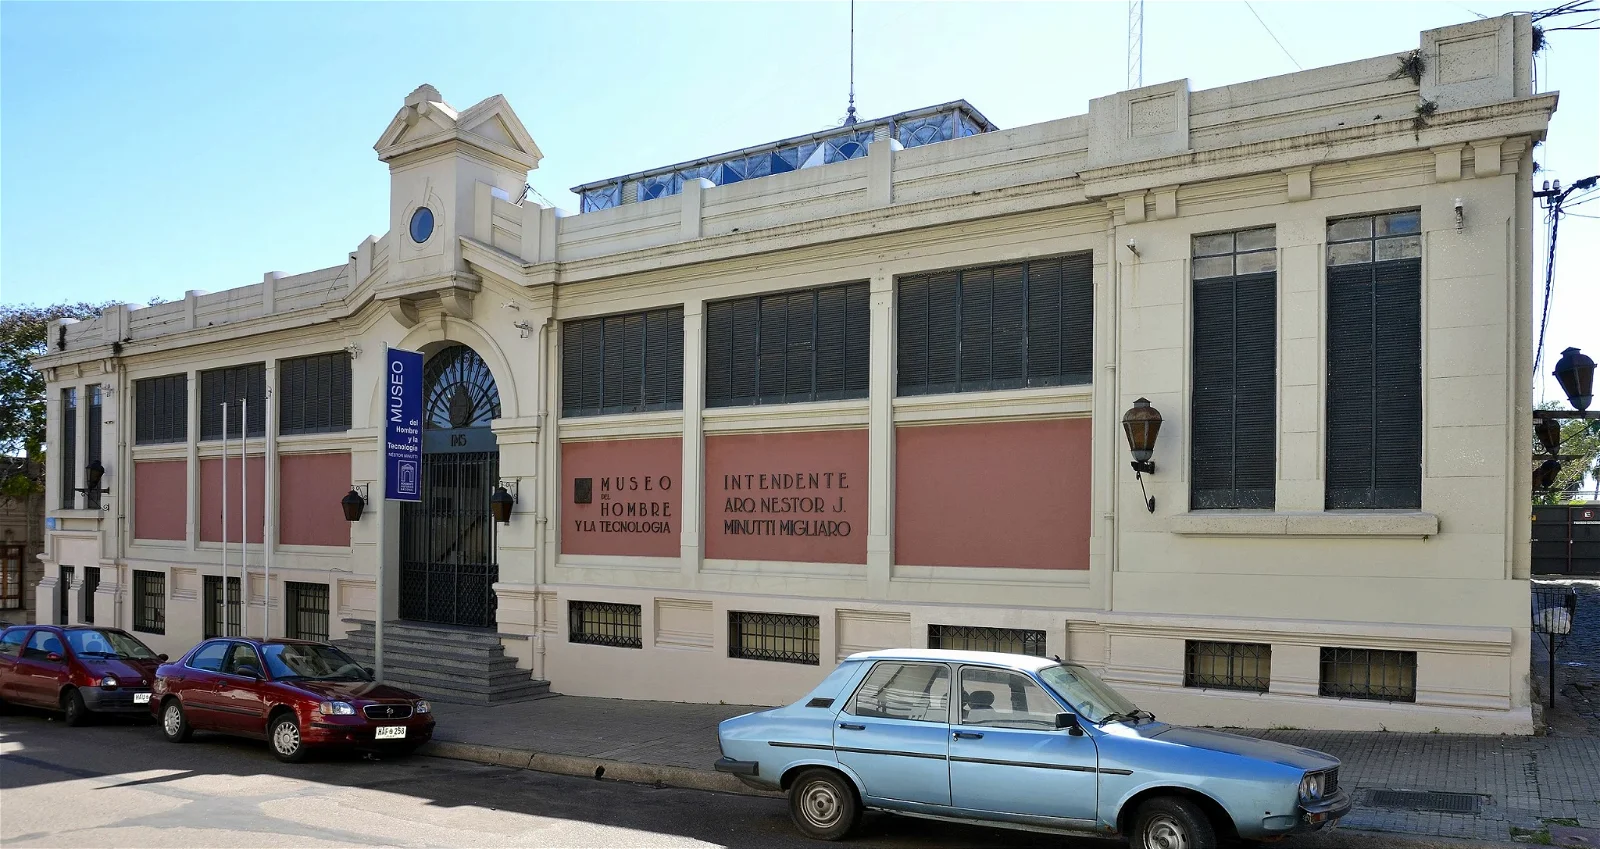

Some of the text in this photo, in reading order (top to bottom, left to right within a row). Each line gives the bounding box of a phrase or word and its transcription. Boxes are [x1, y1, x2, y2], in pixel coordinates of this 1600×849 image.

[391, 360, 403, 422] MUSEO
[396, 426, 418, 434] Hombre
[601, 476, 672, 491] MUSEO
[724, 473, 849, 490] INTENDENTE
[601, 502, 671, 516] HOMBRE
[724, 497, 846, 513] ARQ. NESTOR J.
[575, 520, 670, 533] Y LA TECNOLOGIA
[724, 520, 851, 537] MINUTTI MIGLIARO
